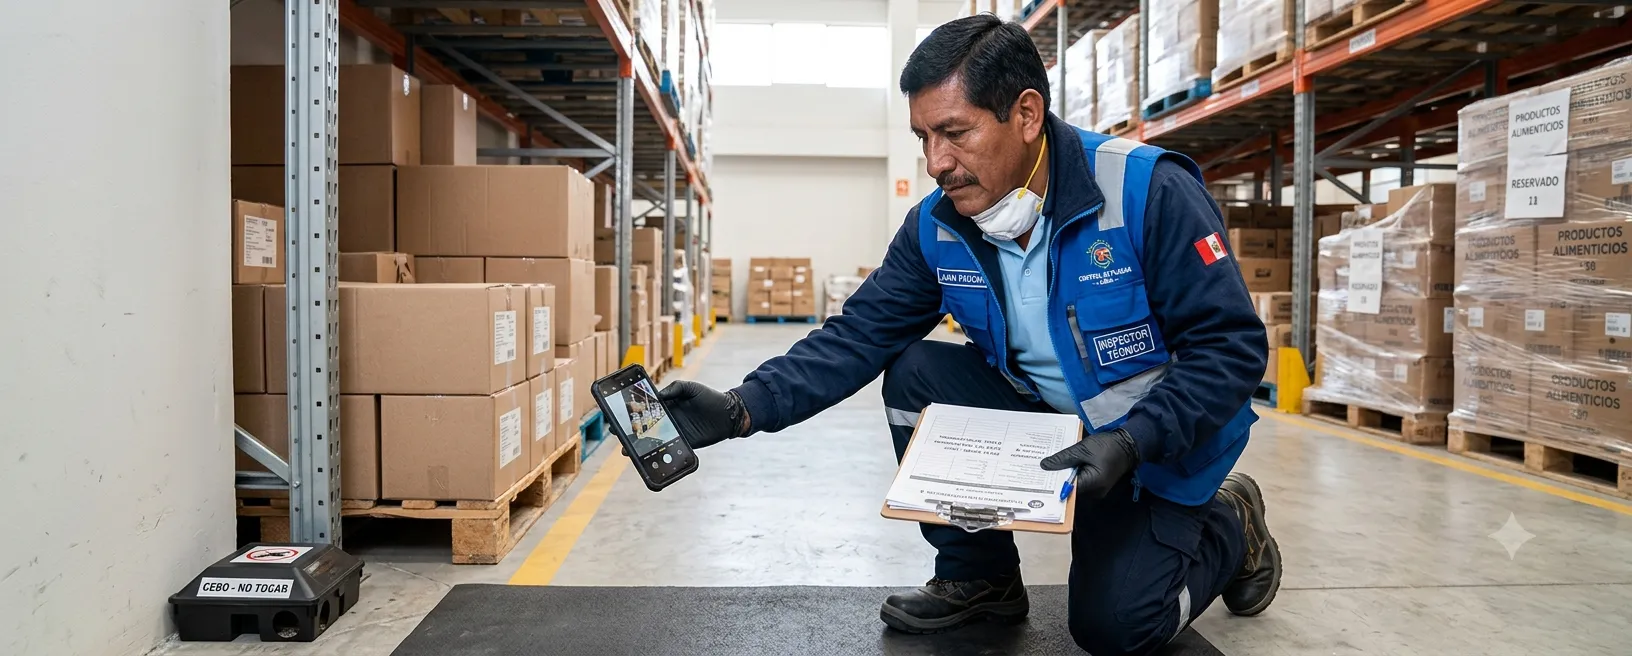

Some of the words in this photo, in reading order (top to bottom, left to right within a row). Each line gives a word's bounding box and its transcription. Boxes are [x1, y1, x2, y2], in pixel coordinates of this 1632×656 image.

[1515, 105, 1561, 122] PRODUCTOS
[1511, 120, 1564, 138] ALIMENTICIOS
[1511, 175, 1559, 188] RESERVADO
[1558, 226, 1623, 241] PRODUCTOS
[1552, 242, 1628, 257] ALIMENTICIOS
[202, 582, 230, 592] CEBO
[237, 583, 253, 593] NO
